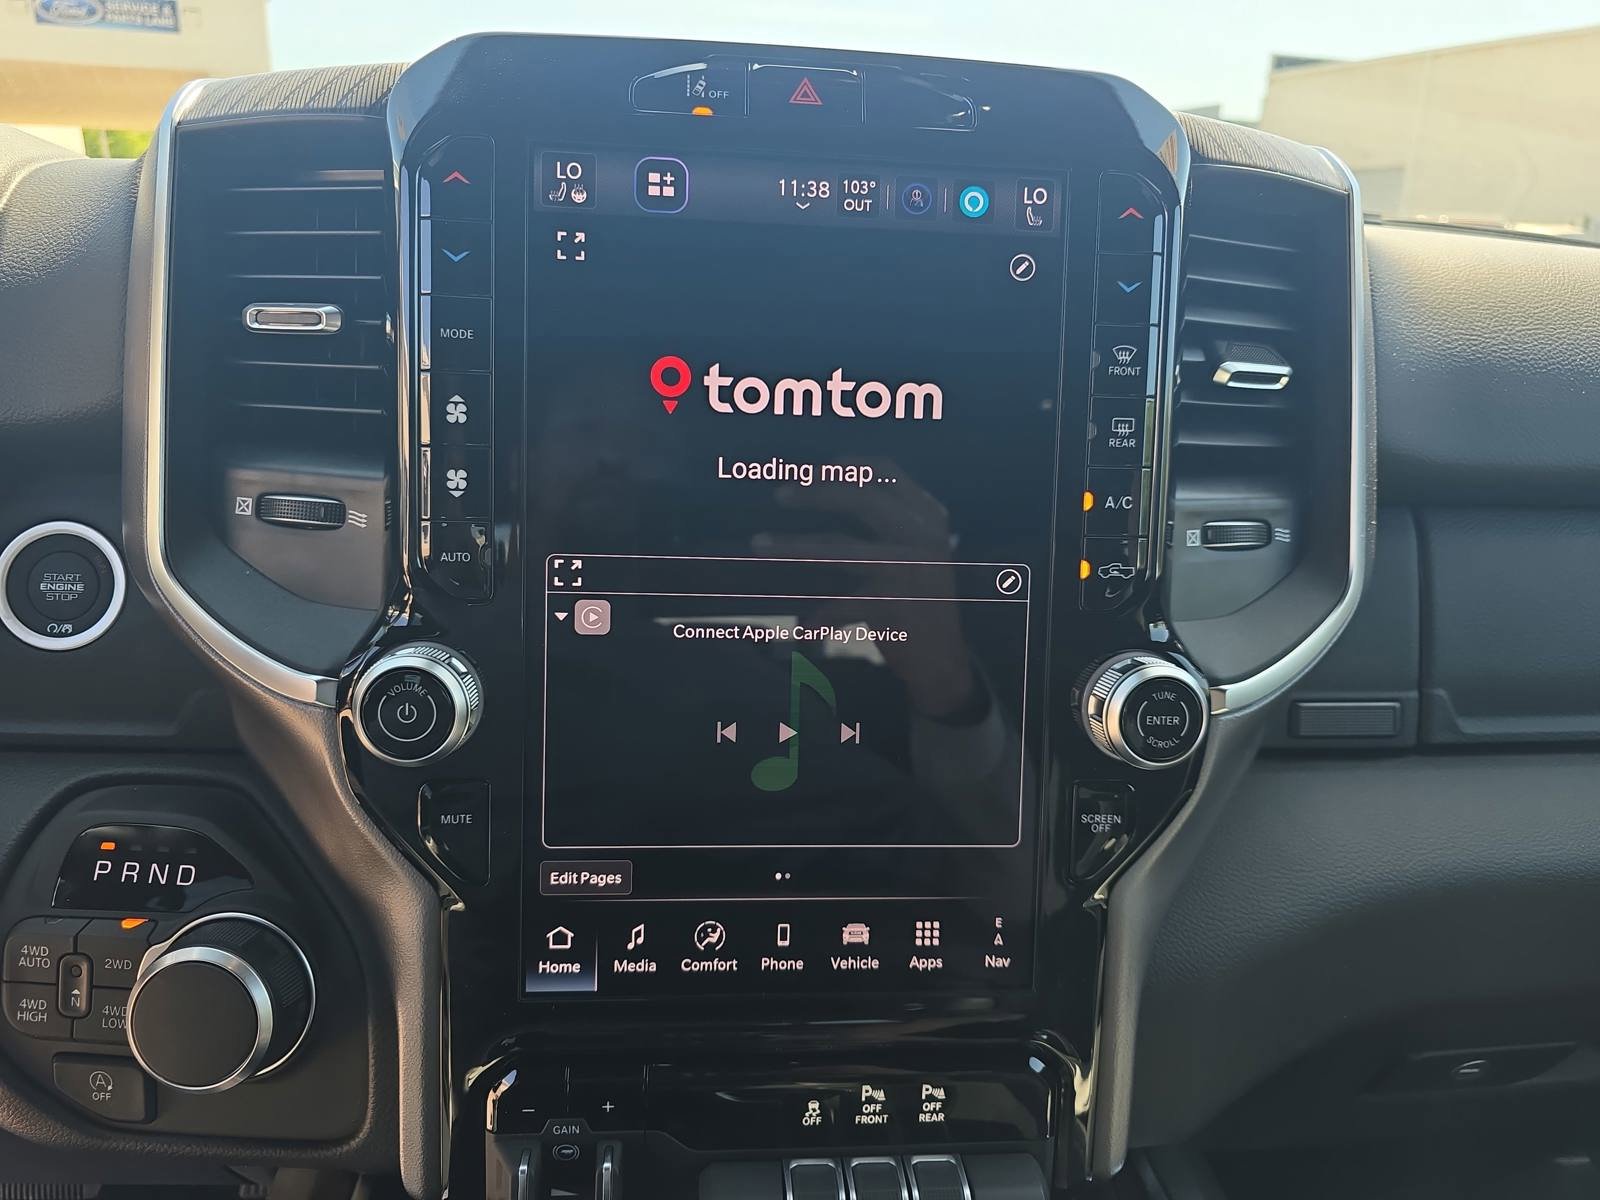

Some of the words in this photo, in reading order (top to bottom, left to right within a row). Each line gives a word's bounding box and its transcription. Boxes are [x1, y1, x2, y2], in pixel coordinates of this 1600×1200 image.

[708, 90, 729, 99] OFF
[556, 161, 582, 179] LO
[778, 178, 831, 199] 11:38
[1023, 187, 1048, 205] LO
[843, 199, 873, 212] OUT
[440, 328, 474, 339] MODE
[1108, 366, 1141, 376] FRONT
[703, 362, 943, 420] tomtom
[1108, 438, 1136, 448] REAR
[718, 456, 813, 486] Loading
[1104, 496, 1134, 509] A/C
[440, 552, 471, 563] AUTO
[43, 573, 82, 582] START
[40, 583, 85, 591] ENGINE
[46, 593, 78, 601] STOP
[673, 624, 740, 641] Connect
[742, 625, 790, 643] Apple
[792, 626, 852, 644] CarPlay
[855, 627, 909, 642] Device
[387, 683, 428, 697] VOLUME
[1152, 692, 1177, 702] TUNE
[1146, 716, 1180, 726] ENTER
[1146, 736, 1180, 749] SCROLL
[440, 814, 473, 825] MUTE
[1080, 814, 1122, 824] SCREEN
[1091, 823, 1111, 833] OFF
[550, 871, 578, 885] Edit
[580, 872, 622, 887] Pages
[21, 945, 49, 957] 4WD
[18, 957, 51, 969] AUTO
[104, 958, 132, 970] 2WD
[538, 961, 581, 974] Home
[613, 960, 657, 973] Media
[681, 958, 738, 972] Comfort
[761, 957, 804, 971] Phone
[831, 956, 880, 970] Vehicle
[909, 956, 943, 972] Apps
[984, 955, 1011, 968] Nav
[19, 999, 47, 1010] 4WD
[71, 996, 80, 1008] N
[17, 1011, 47, 1023] HIGH
[92, 1092, 111, 1101] OFF
[862, 1104, 882, 1113] OFF
[922, 1102, 942, 1112] OFF
[802, 1116, 822, 1126] OFF
[855, 1114, 888, 1124] FRONT
[918, 1113, 945, 1122] REAR
[552, 1125, 580, 1135] GAIN
